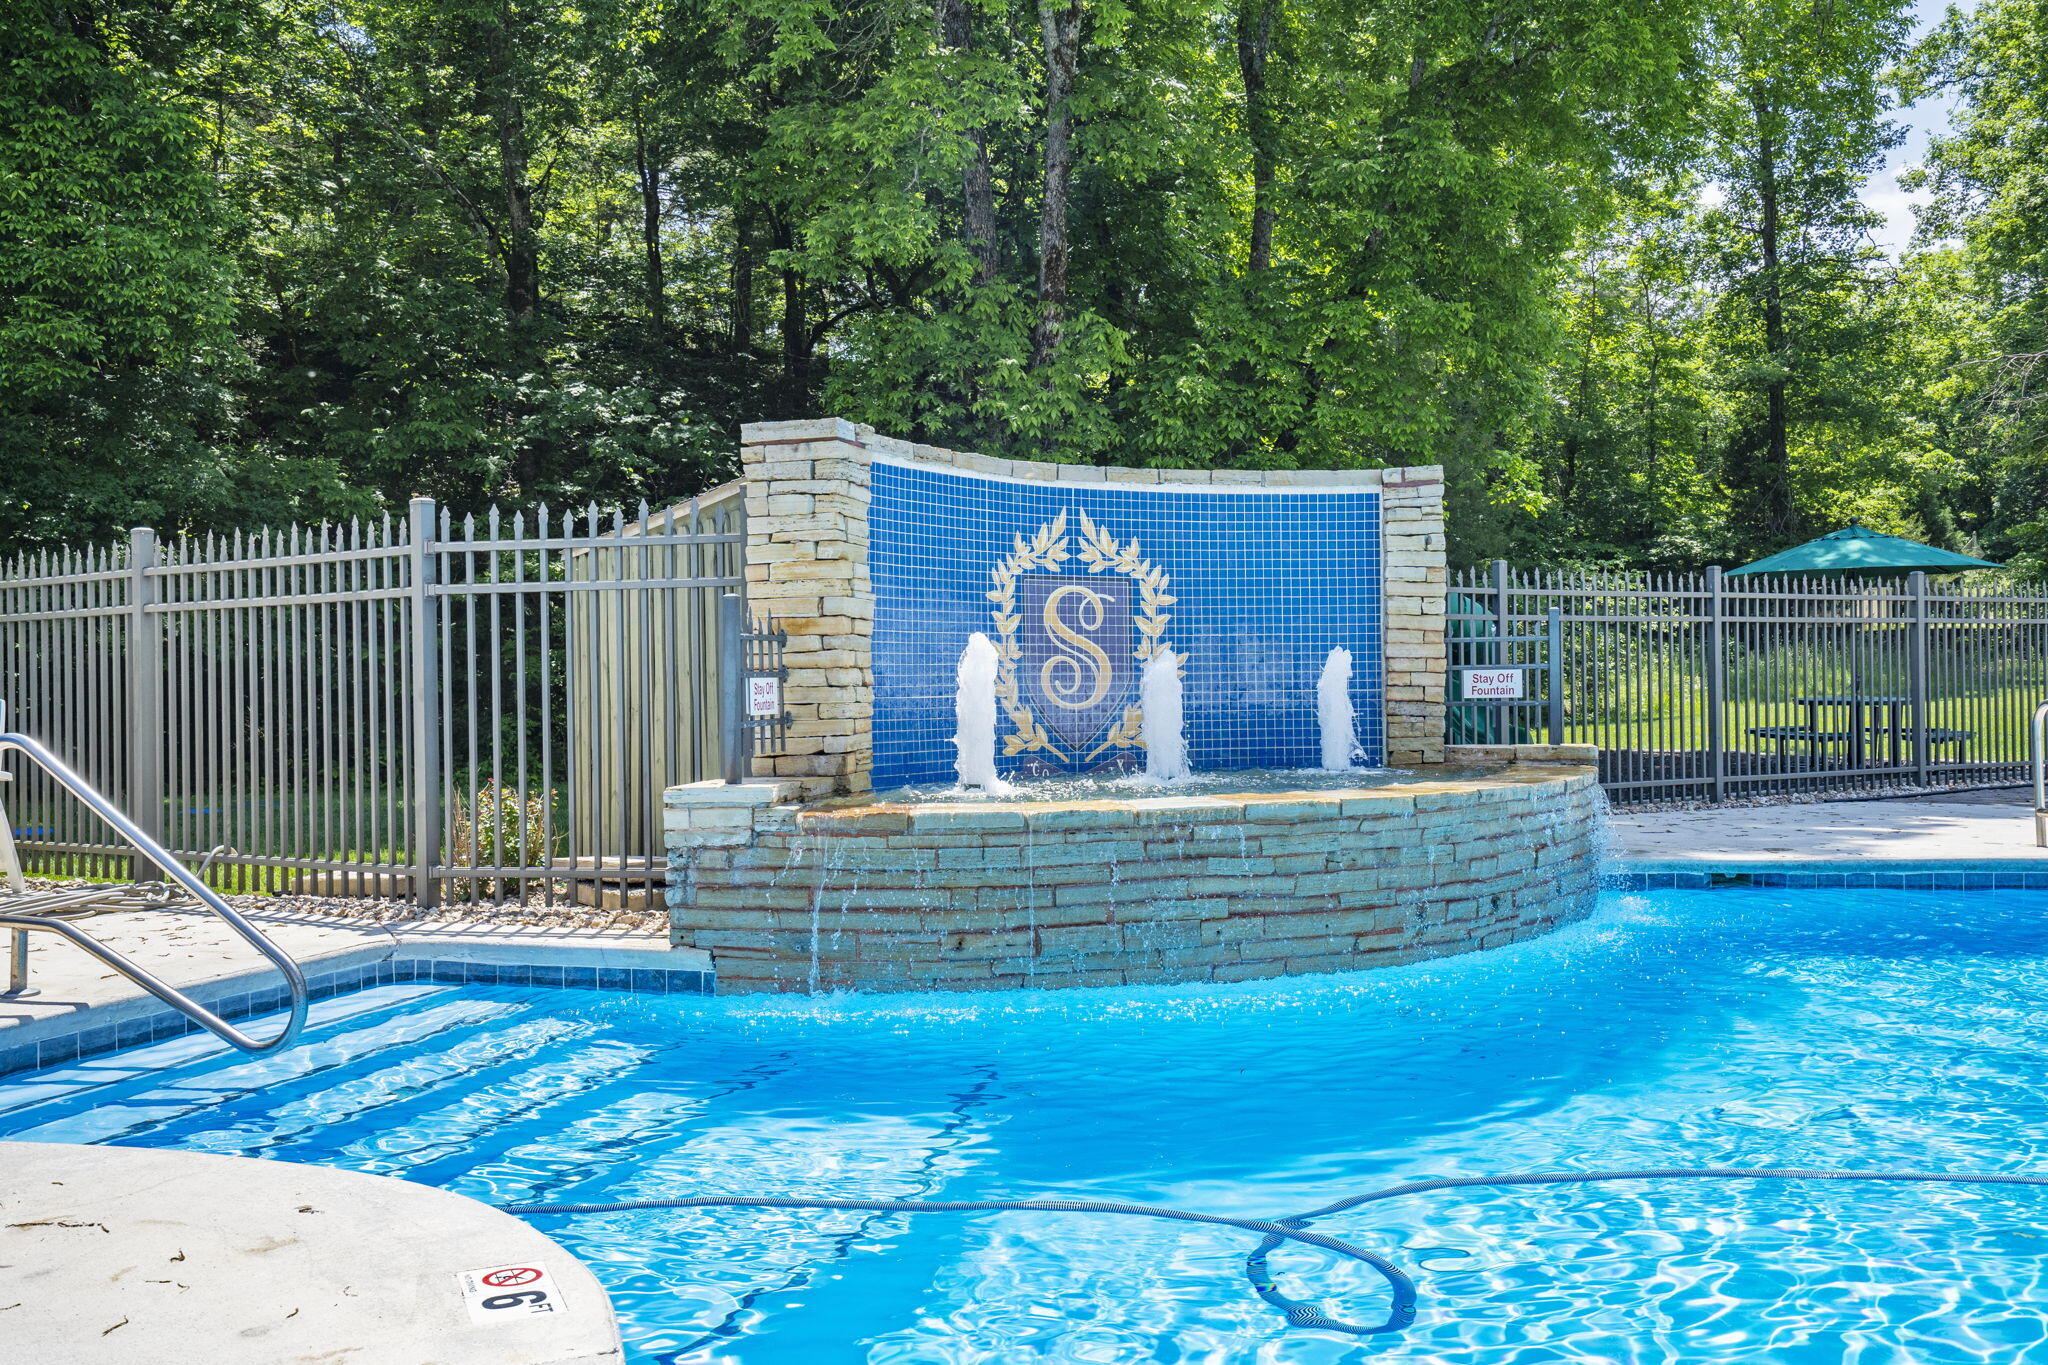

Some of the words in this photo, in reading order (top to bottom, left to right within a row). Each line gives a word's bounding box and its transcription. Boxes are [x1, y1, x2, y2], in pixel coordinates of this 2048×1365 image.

[1041, 585, 1115, 710] S
[1472, 673, 1495, 686] Stay
[1497, 673, 1514, 683] Off
[753, 682, 765, 698] Stay
[765, 682, 774, 695] Off
[1471, 685, 1515, 695] Fountain
[753, 698, 775, 711] Fountain
[481, 1290, 547, 1310] 6
